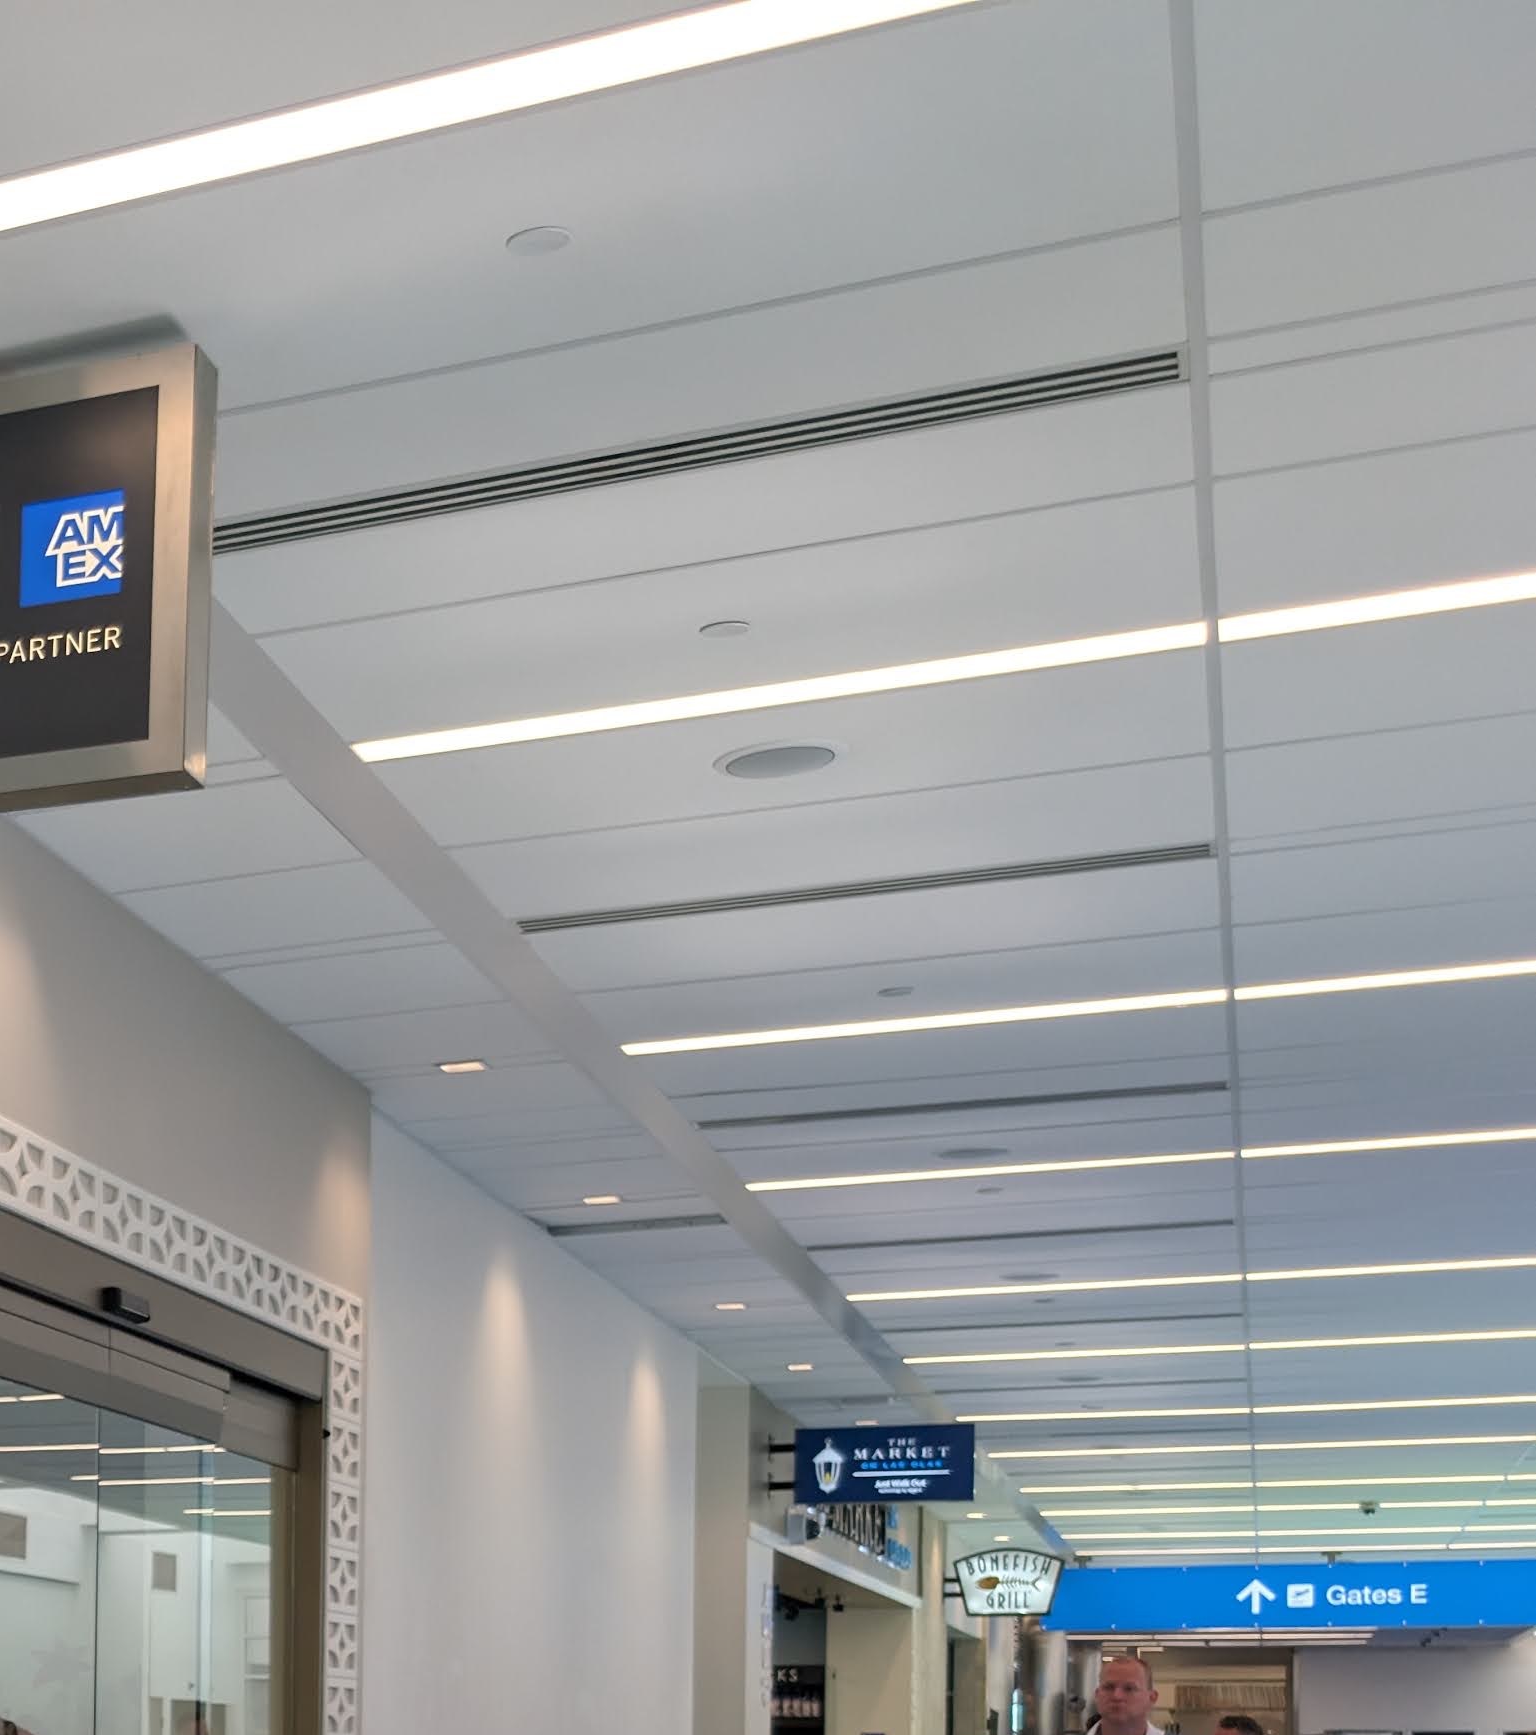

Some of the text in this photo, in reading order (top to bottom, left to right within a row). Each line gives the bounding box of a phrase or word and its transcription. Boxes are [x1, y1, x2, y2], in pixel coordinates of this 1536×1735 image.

[887, 1438, 917, 1447] THE
[853, 1446, 950, 1460] MARKET
[965, 1553, 1052, 1576] BONEFISH
[986, 1592, 1029, 1609] GRILL
[1326, 1584, 1428, 1607] Gates E
